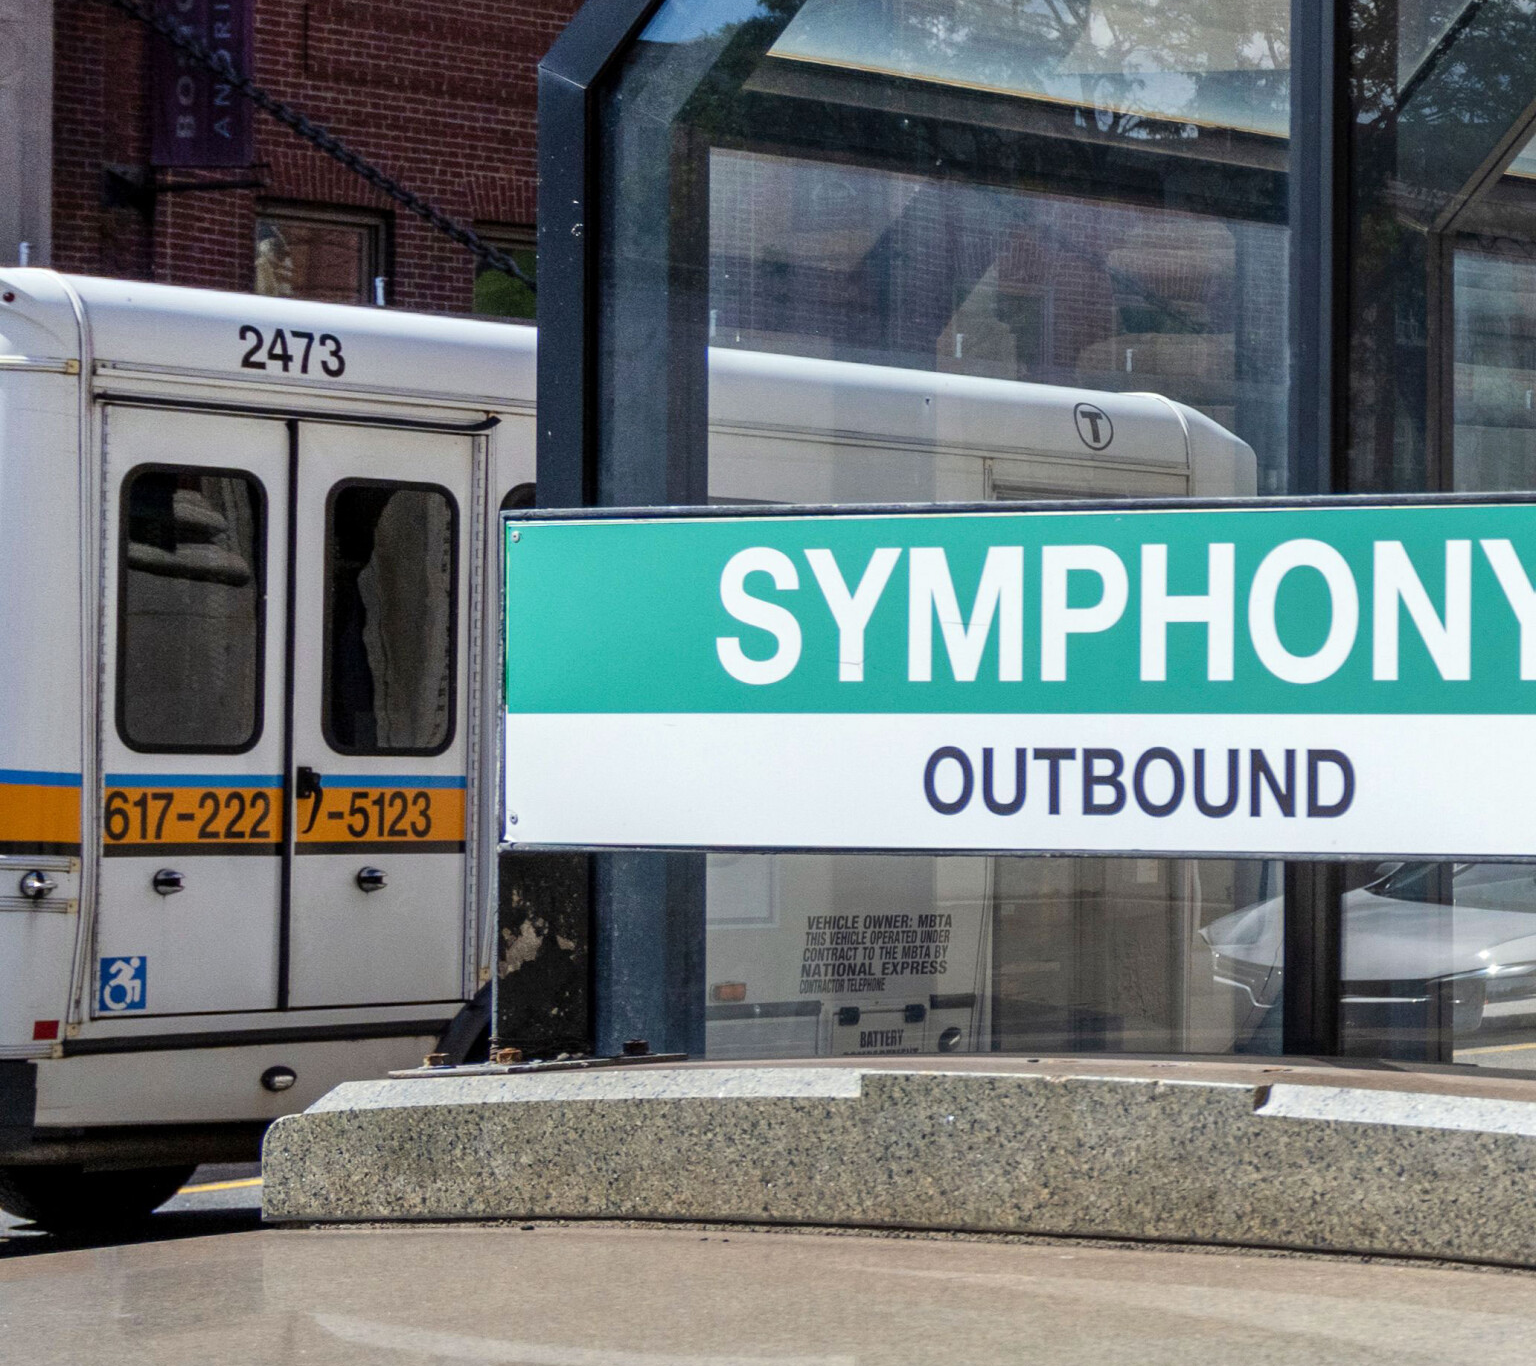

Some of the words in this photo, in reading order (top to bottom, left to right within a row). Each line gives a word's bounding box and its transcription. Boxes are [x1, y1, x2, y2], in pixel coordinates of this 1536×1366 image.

[238, 324, 346, 378] 2473
[922, 745, 1356, 819] OUTBOUND
[807, 915, 859, 930] VEHICLE
[863, 915, 913, 929] OWNER:
[918, 914, 952, 928] MBTA
[805, 932, 826, 946] THIS
[829, 931, 867, 946] VEHICLE
[870, 930, 917, 945] OPERATED
[920, 929, 950, 944] UNDER
[803, 947, 859, 962] CONTRACT
[862, 946, 875, 961] TO
[879, 945, 898, 960] THE
[901, 945, 931, 959] MBTA
[934, 944, 949, 959] BY
[800, 962, 876, 978] NATIONAL
[881, 960, 948, 976] EXPRESS
[799, 979, 845, 994] CONTRACTOR
[846, 977, 886, 992] TELEPHONE
[860, 1029, 904, 1048] BATTERY
